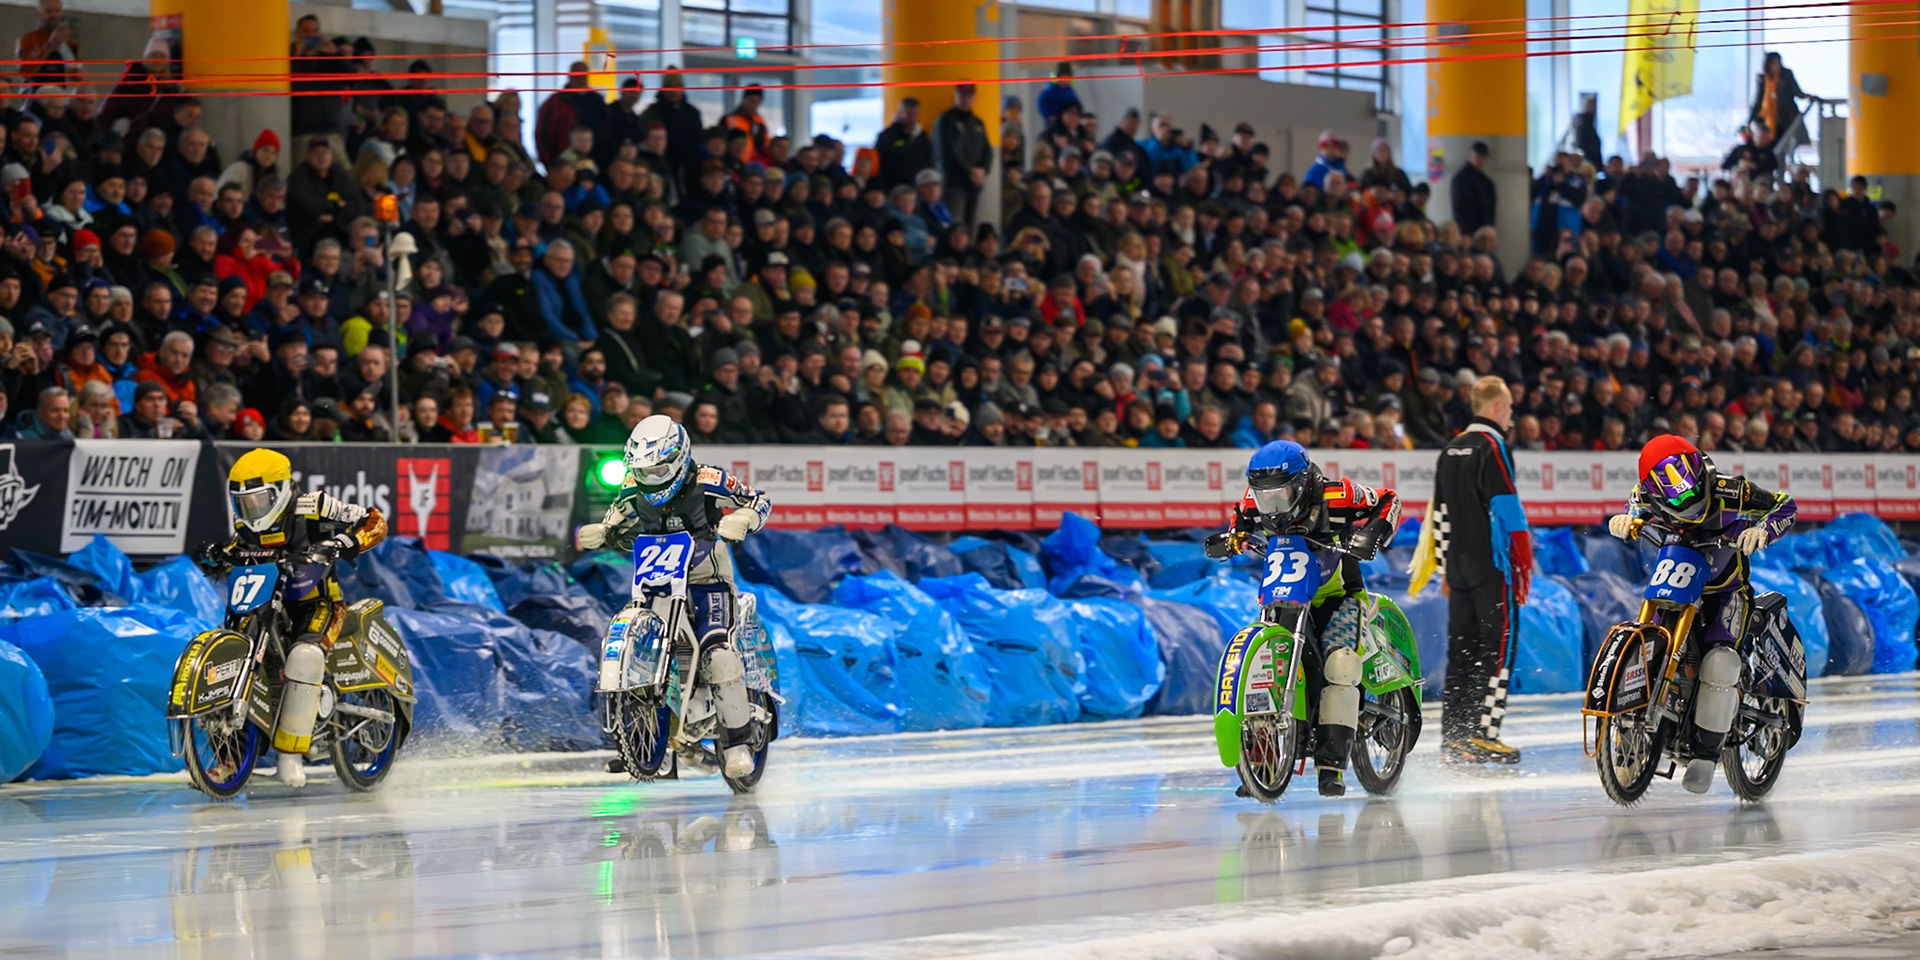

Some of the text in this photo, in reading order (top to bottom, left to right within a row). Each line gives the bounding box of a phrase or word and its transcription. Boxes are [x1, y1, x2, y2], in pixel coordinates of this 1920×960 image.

[81, 456, 189, 488] WATCH ON
[308, 471, 392, 522] Fuchs
[70, 499, 181, 529] FIM-MOTO.TV
[637, 544, 684, 576] 24
[1262, 551, 1309, 588] 33
[1650, 558, 1696, 589] 88
[231, 574, 266, 606] 67
[1271, 586, 1292, 596] FIM
